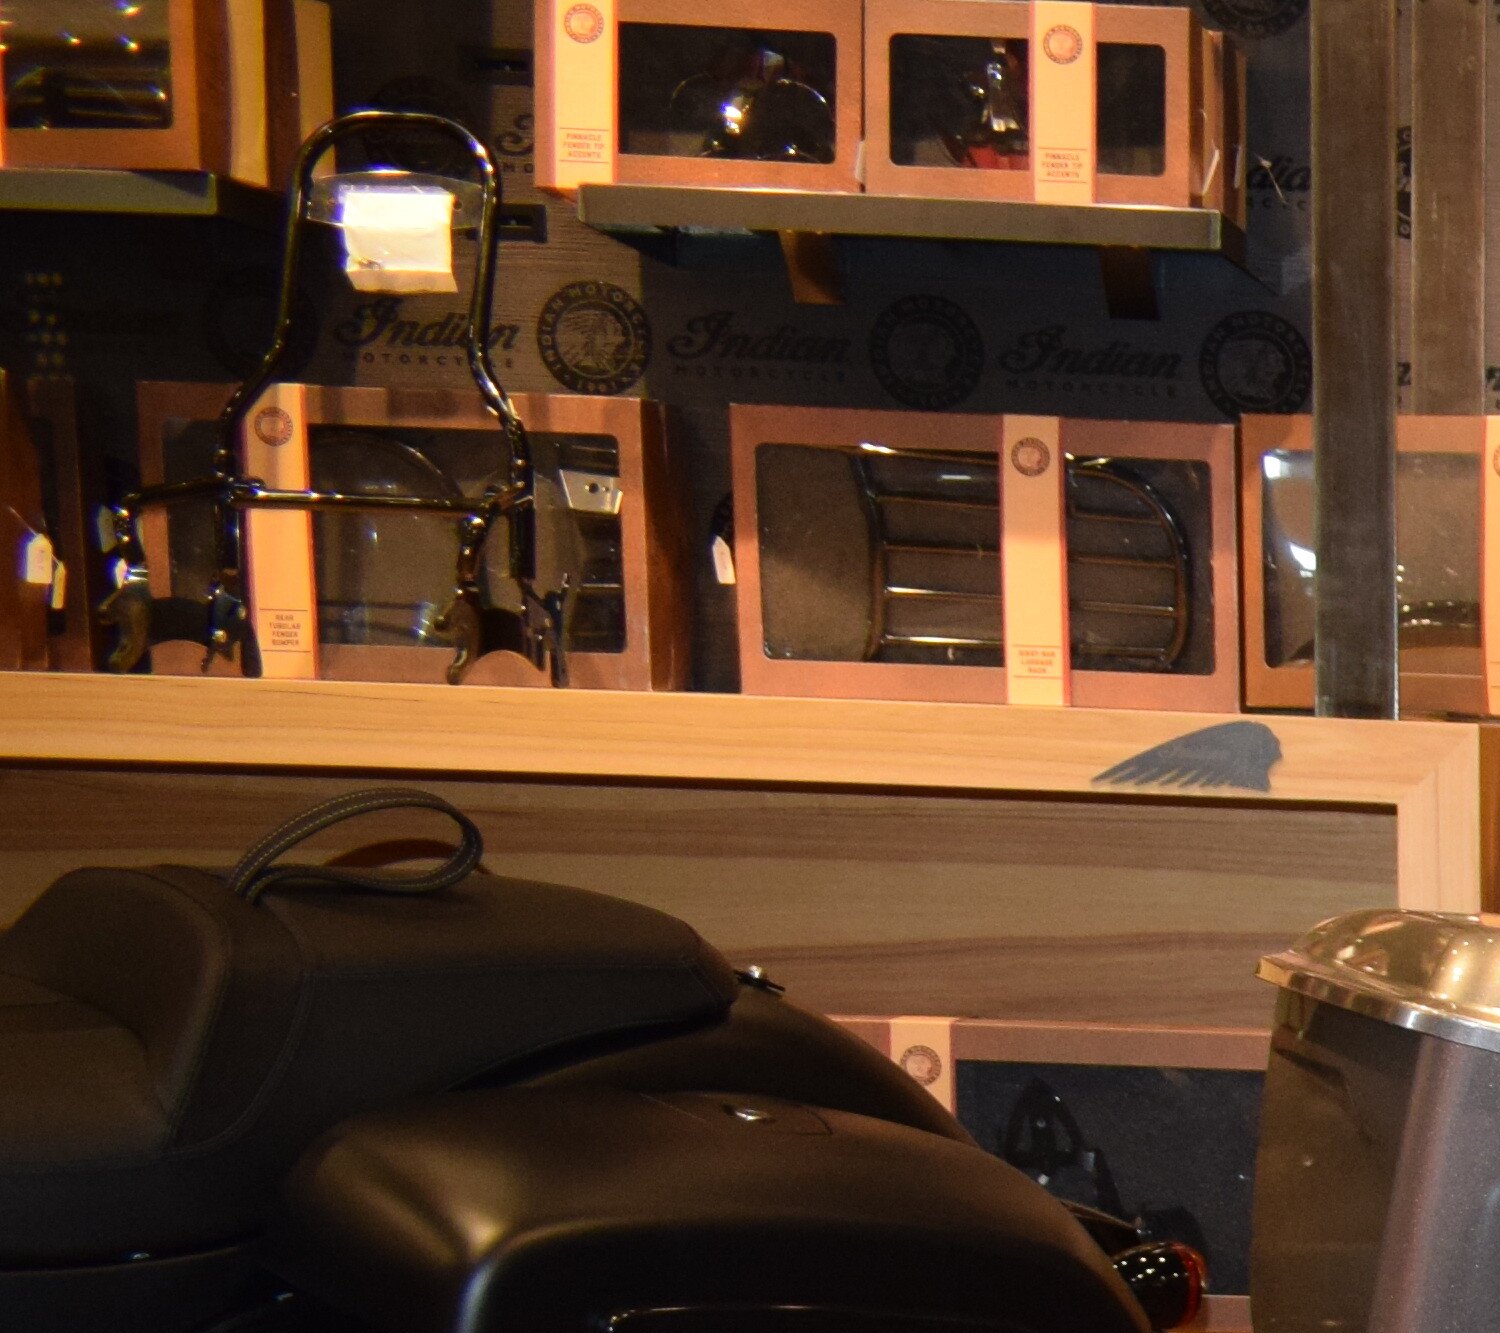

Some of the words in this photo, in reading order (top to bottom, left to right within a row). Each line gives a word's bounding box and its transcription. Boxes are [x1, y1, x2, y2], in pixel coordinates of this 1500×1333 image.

[335, 297, 521, 350] Indin
[667, 311, 852, 364] Indian
[999, 324, 1183, 379] Indian
